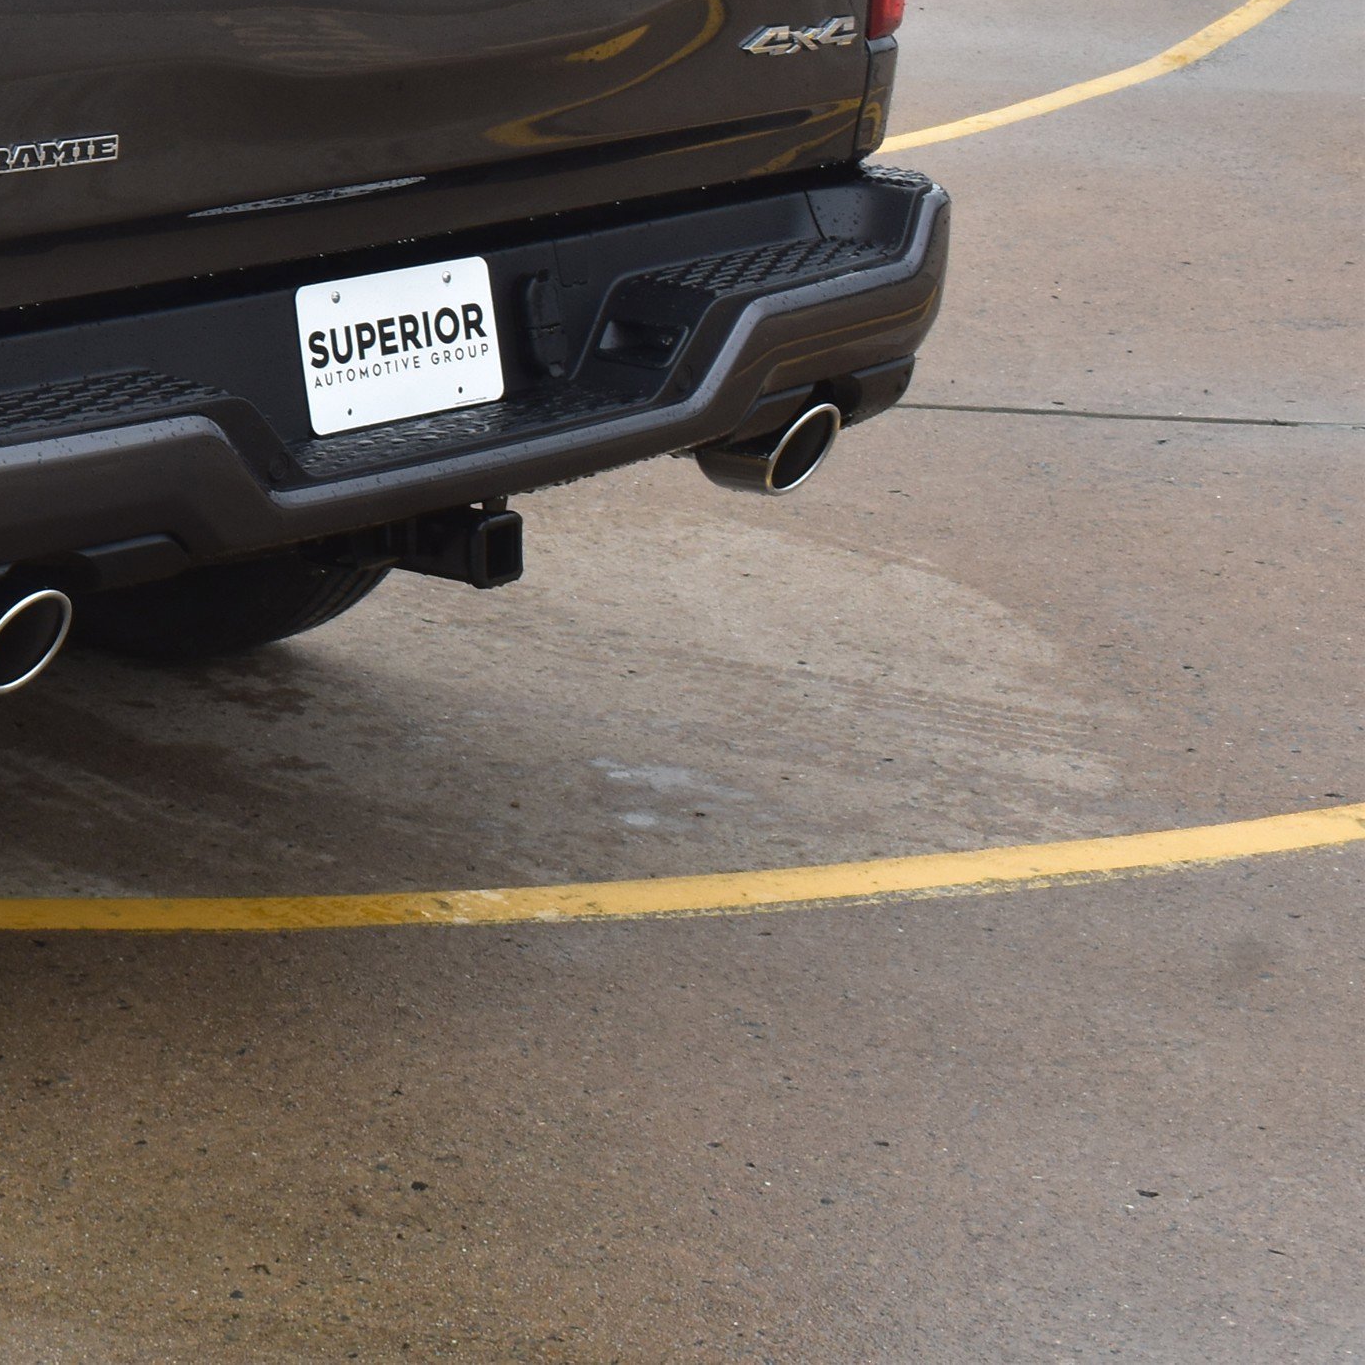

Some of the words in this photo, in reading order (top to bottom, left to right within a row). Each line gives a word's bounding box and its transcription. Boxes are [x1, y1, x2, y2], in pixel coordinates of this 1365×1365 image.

[308, 303, 488, 369] SUPERIOR
[314, 355, 421, 388] AUTOMOTIVE
[430, 343, 489, 365] GROUP
